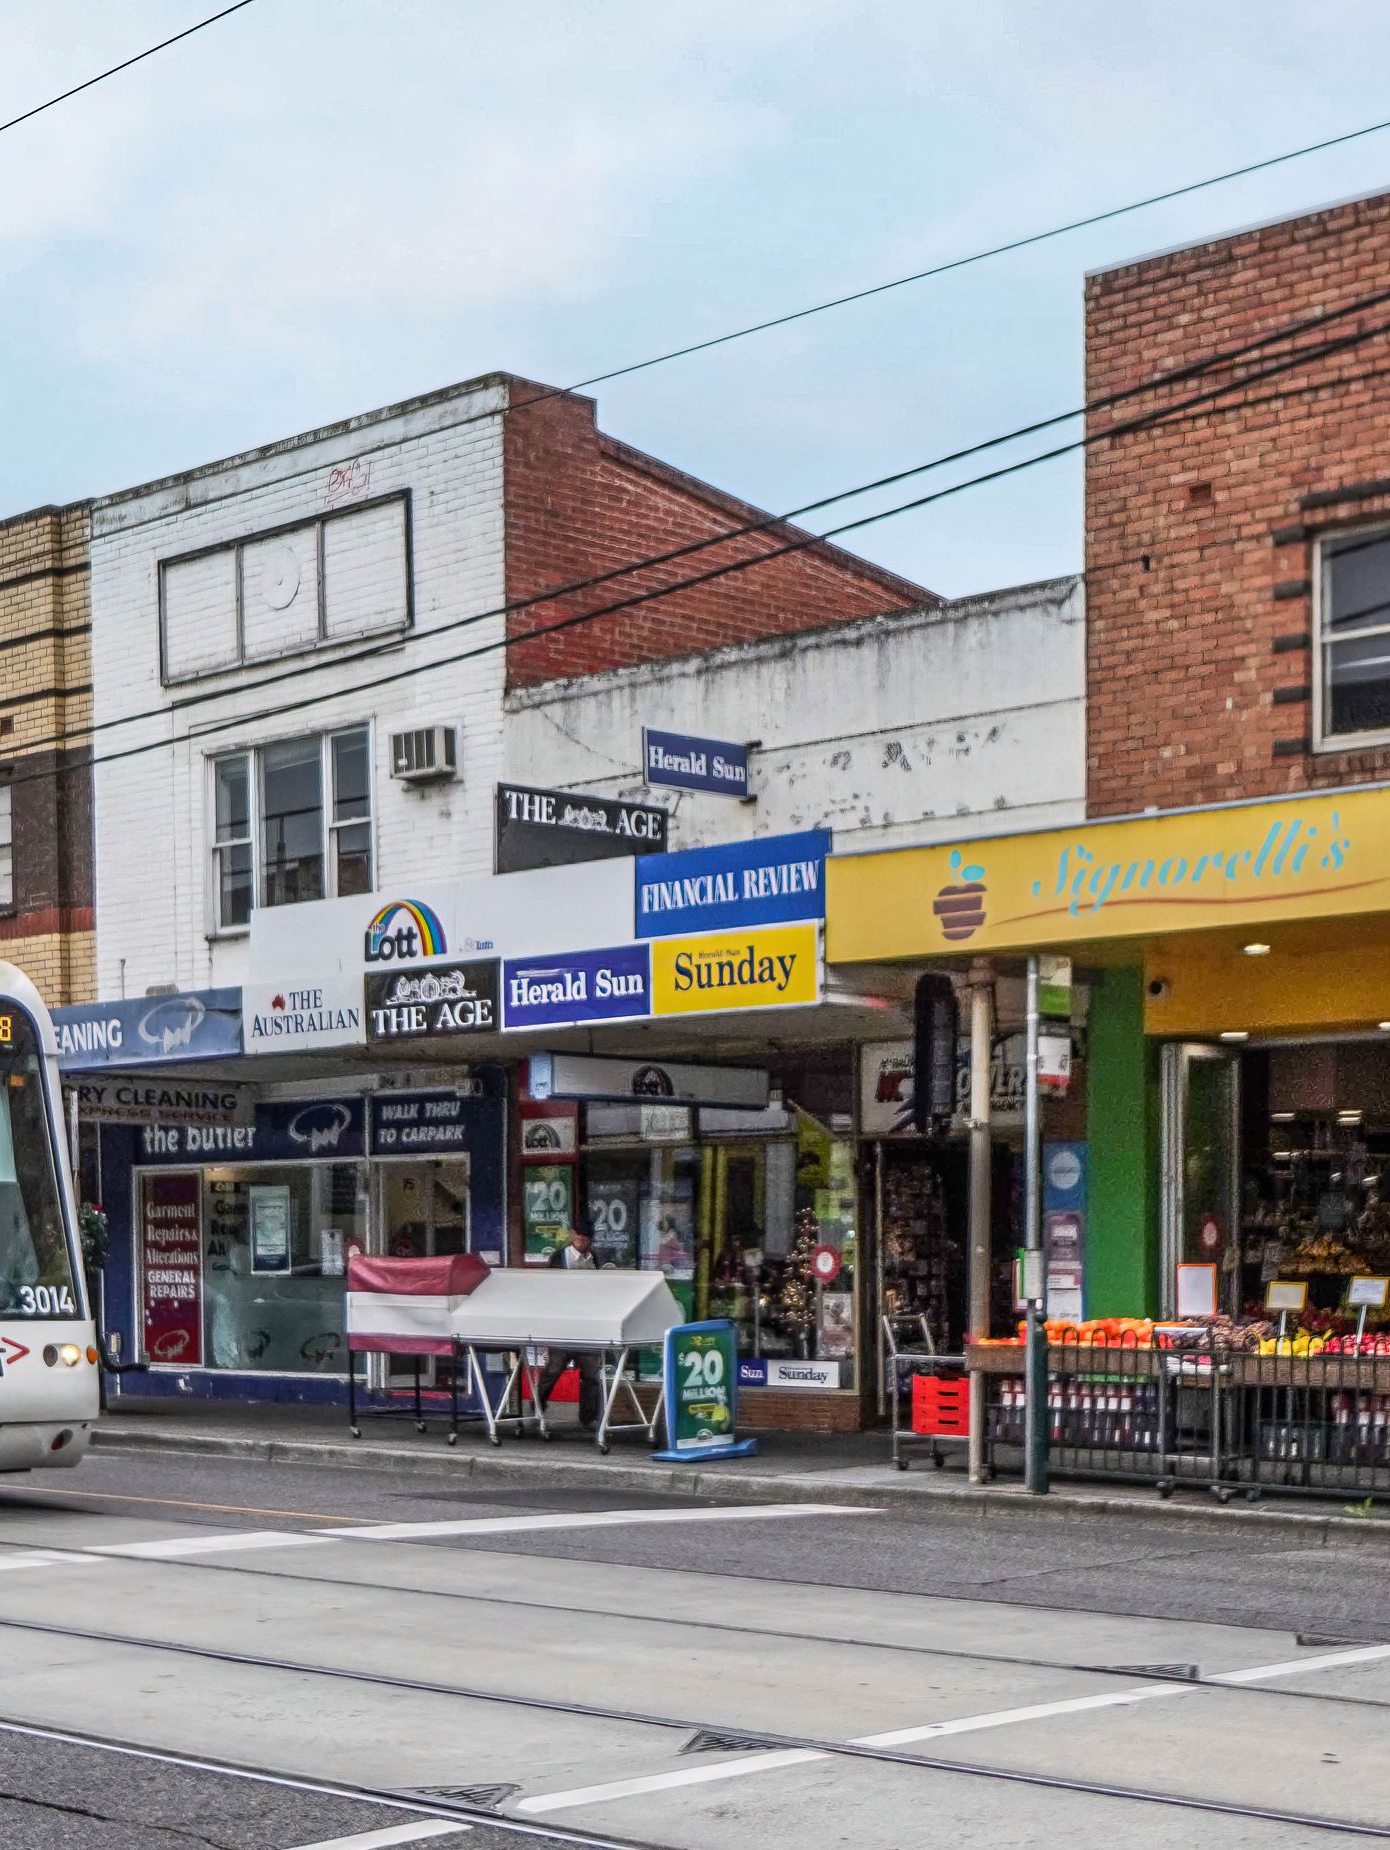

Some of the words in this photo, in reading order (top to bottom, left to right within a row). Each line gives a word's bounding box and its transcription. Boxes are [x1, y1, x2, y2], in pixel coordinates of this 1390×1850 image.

[649, 745, 707, 778] Herald
[713, 757, 746, 783] Sun
[506, 790, 556, 824] THE
[615, 808, 662, 840] AGE
[1031, 811, 1351, 917] Signorelli's
[642, 872, 739, 914] FINANCIAL
[743, 859, 820, 899] REVIEW
[674, 945, 798, 991] Sunday
[289, 989, 323, 1011] THE
[510, 971, 587, 1008] Herald
[595, 969, 644, 998] Sun
[250, 1008, 359, 1038] AUSTRALIAN
[372, 1006, 427, 1035] THE
[435, 1000, 493, 1028] AGE
[115, 1087, 238, 1111] CLEANING
[381, 1104, 418, 1121] WALK
[424, 1101, 460, 1118] THRU
[143, 1123, 180, 1154] the
[380, 1127, 397, 1144] TO
[401, 1123, 466, 1143] CARPARK
[146, 1201, 196, 1219] Garment
[147, 1270, 196, 1285] GENERAL
[149, 1285, 196, 1299] REPAIRS
[20, 1285, 76, 1314] 3014
[740, 1365, 763, 1379] Sun
[778, 1366, 829, 1384] Sunday
